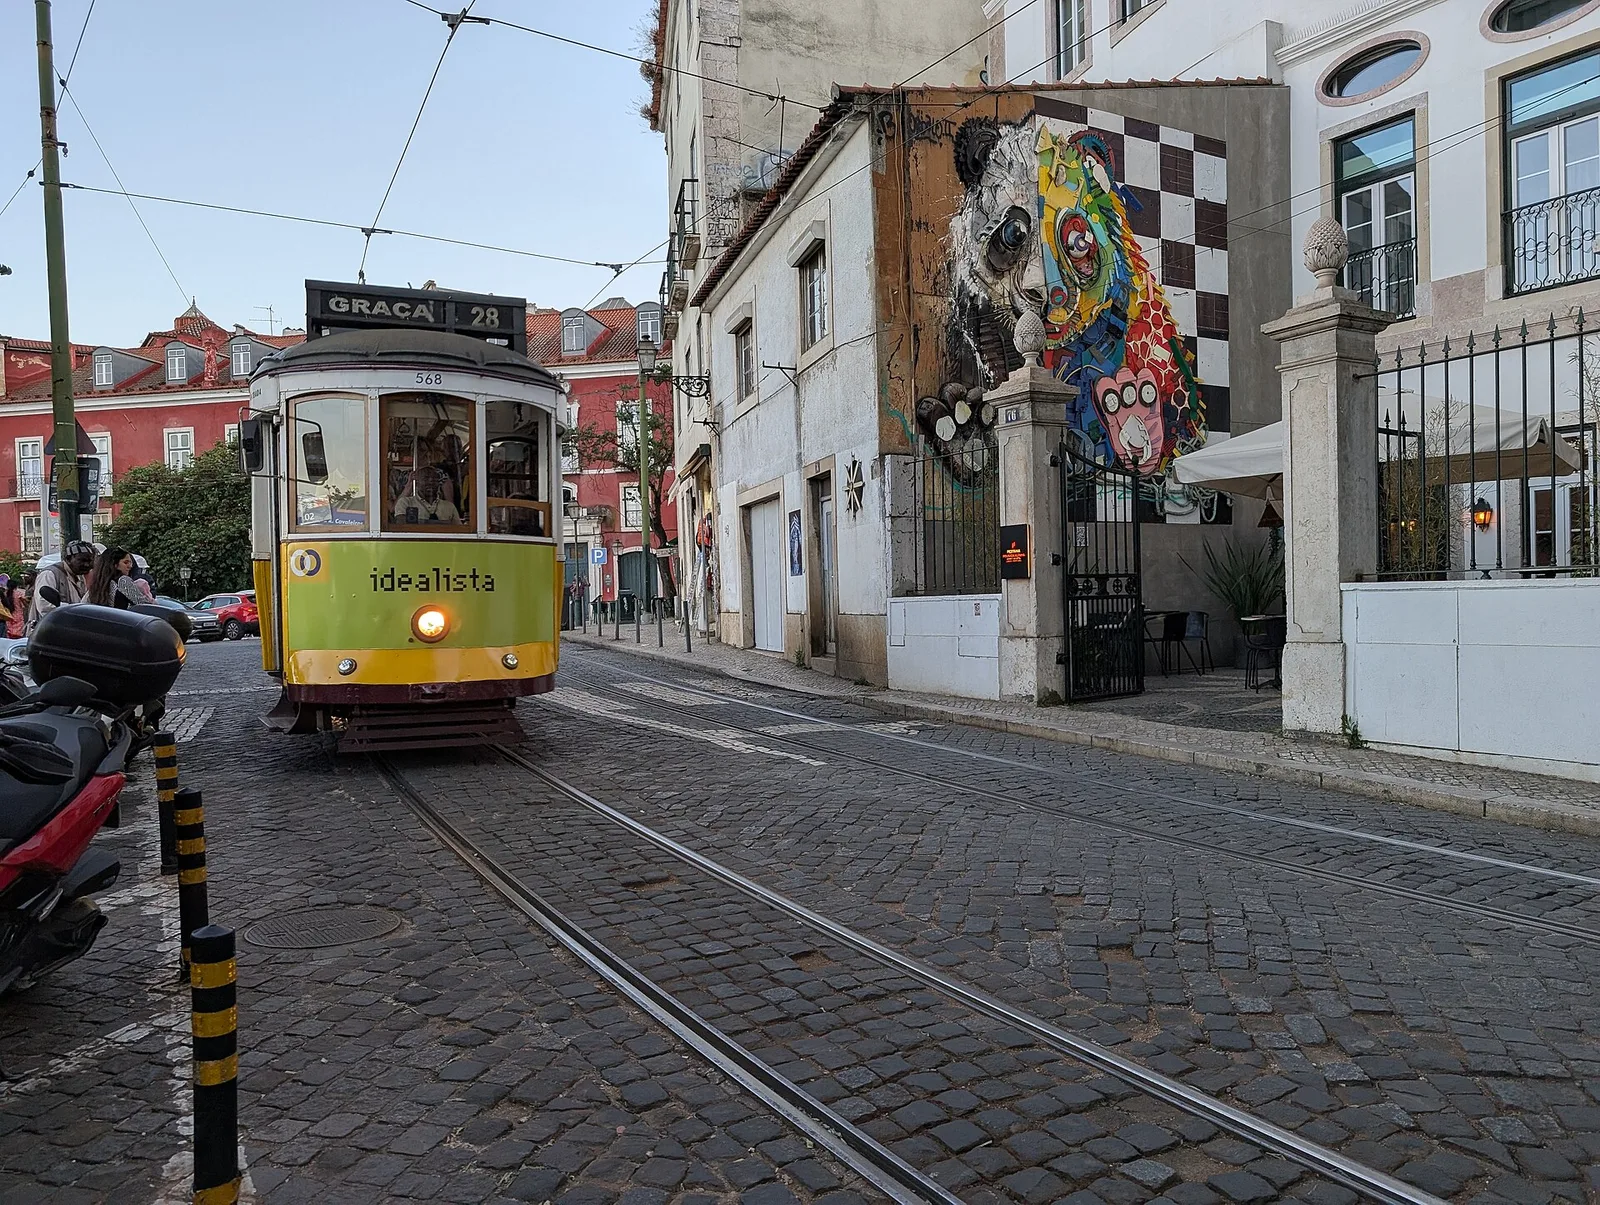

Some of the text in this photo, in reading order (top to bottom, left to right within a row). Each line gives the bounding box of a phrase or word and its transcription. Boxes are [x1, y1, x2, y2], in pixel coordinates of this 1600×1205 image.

[471, 306, 499, 329] 28
[415, 373, 442, 385] 568
[594, 550, 604, 563] P
[370, 567, 495, 592] idealista
